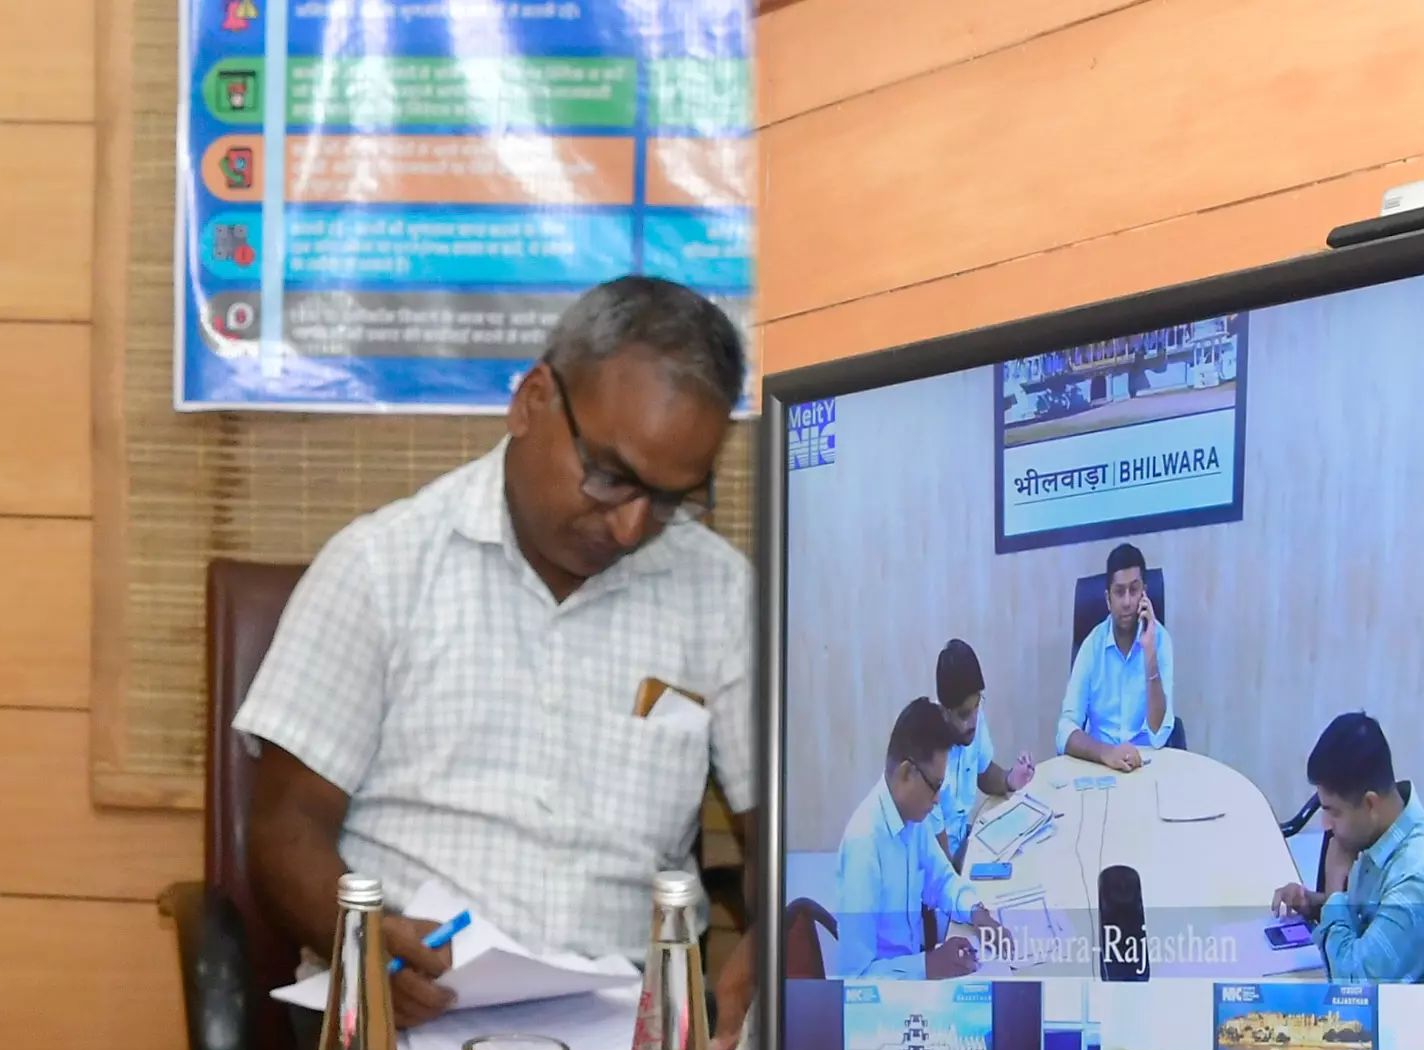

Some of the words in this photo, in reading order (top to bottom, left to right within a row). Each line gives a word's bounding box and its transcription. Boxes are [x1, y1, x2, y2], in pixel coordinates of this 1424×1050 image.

[789, 399, 835, 428] MeitY
[788, 422, 835, 470] NIC
[1119, 446, 1220, 483] BHILWARA
[1014, 464, 1108, 496] भीलवाड़ा
[978, 924, 1238, 974] Bhilwara-Rajasthan
